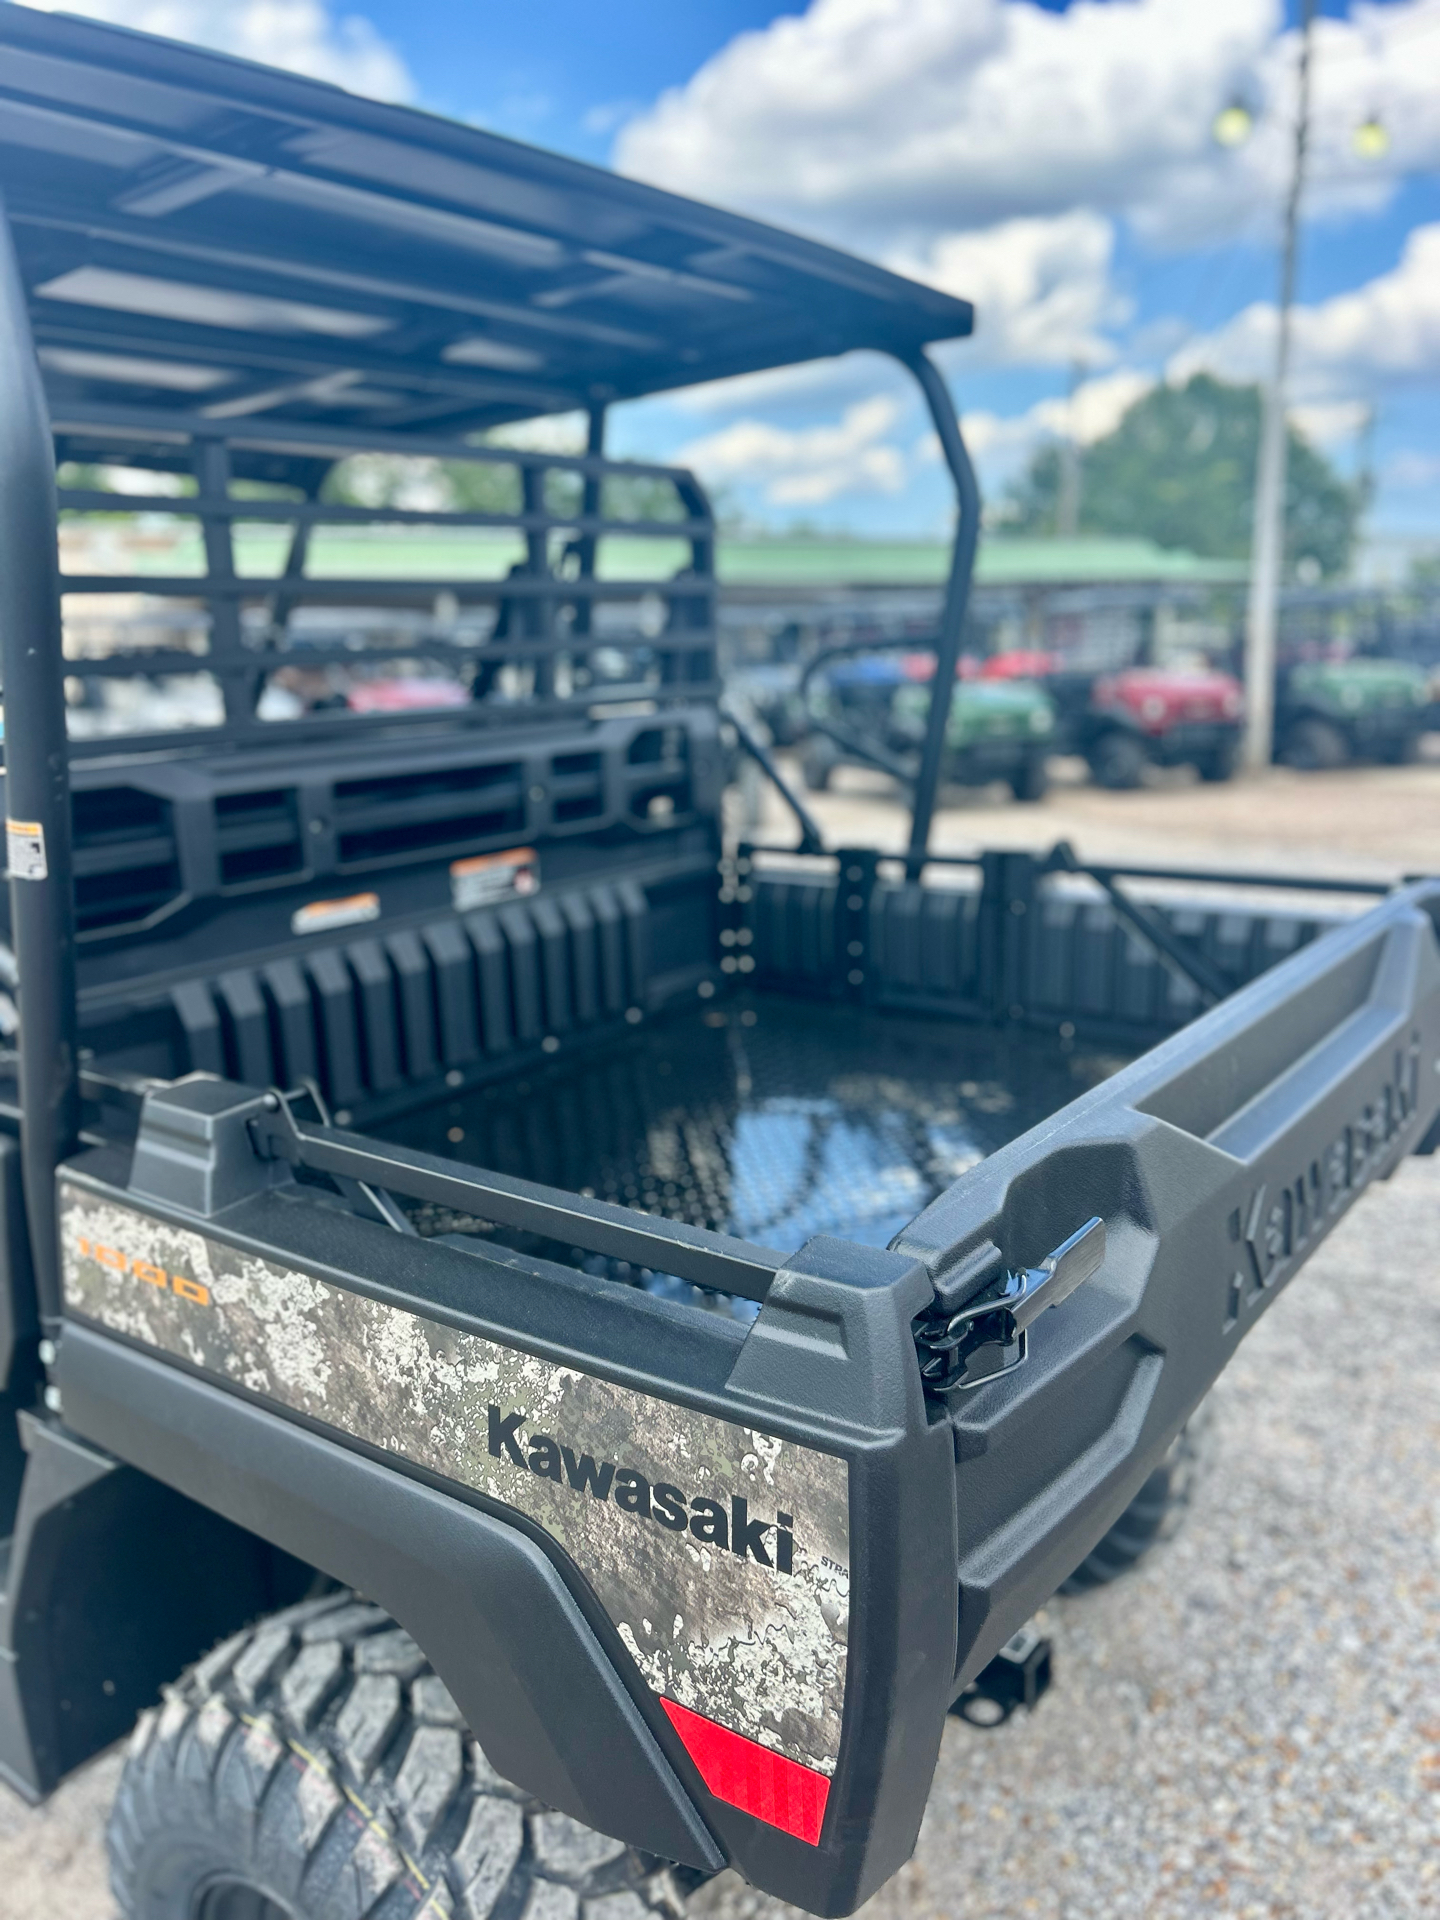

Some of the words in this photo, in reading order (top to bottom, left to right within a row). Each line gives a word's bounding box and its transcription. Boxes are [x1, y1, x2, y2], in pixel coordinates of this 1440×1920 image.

[1222, 1030, 1420, 1335] Kawasaki
[78, 1236, 209, 1306] 1000
[487, 1403, 793, 1575] Kawasaki
